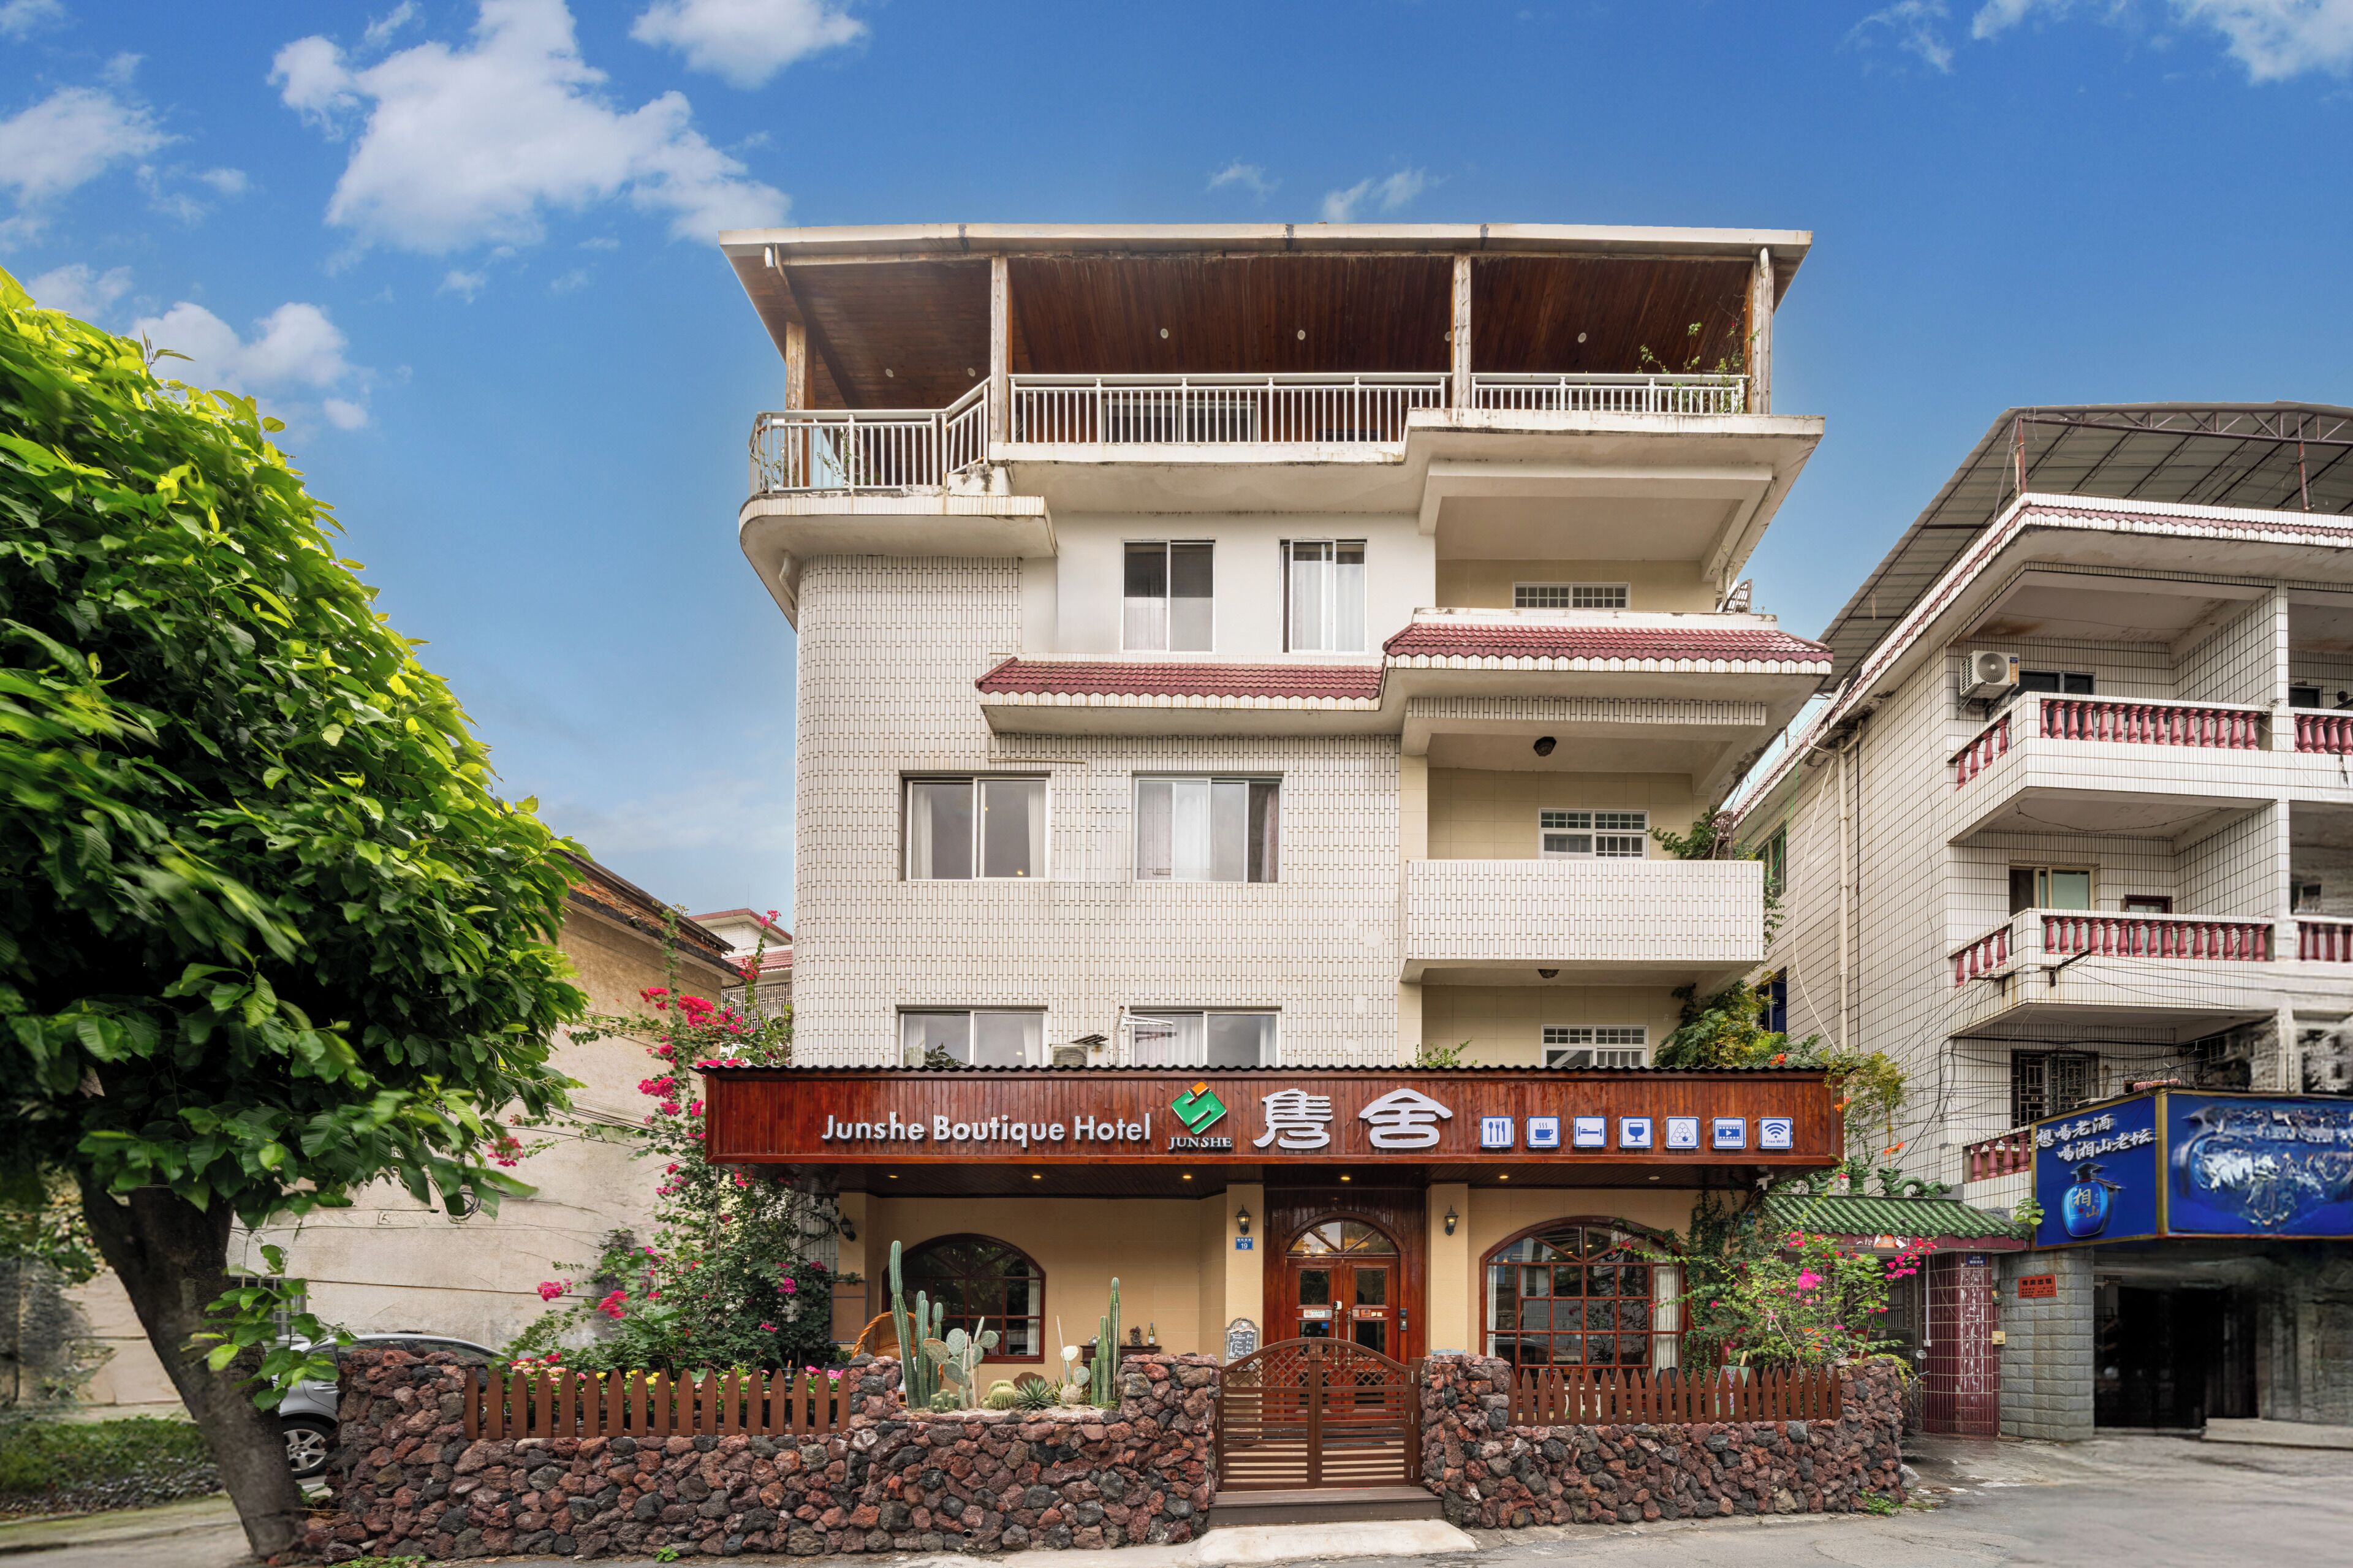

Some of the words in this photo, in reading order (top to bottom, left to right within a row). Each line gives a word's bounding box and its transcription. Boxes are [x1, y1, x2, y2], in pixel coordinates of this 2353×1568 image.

[821, 1111, 925, 1140] Junshe
[933, 1114, 1065, 1148] Boutique
[1075, 1113, 1151, 1140] Hotel
[1168, 1137, 1233, 1150] JUNSHE
[2036, 1114, 2112, 1149] 想喝老酒
[2056, 1129, 2154, 1162] 喝湘山老坛
